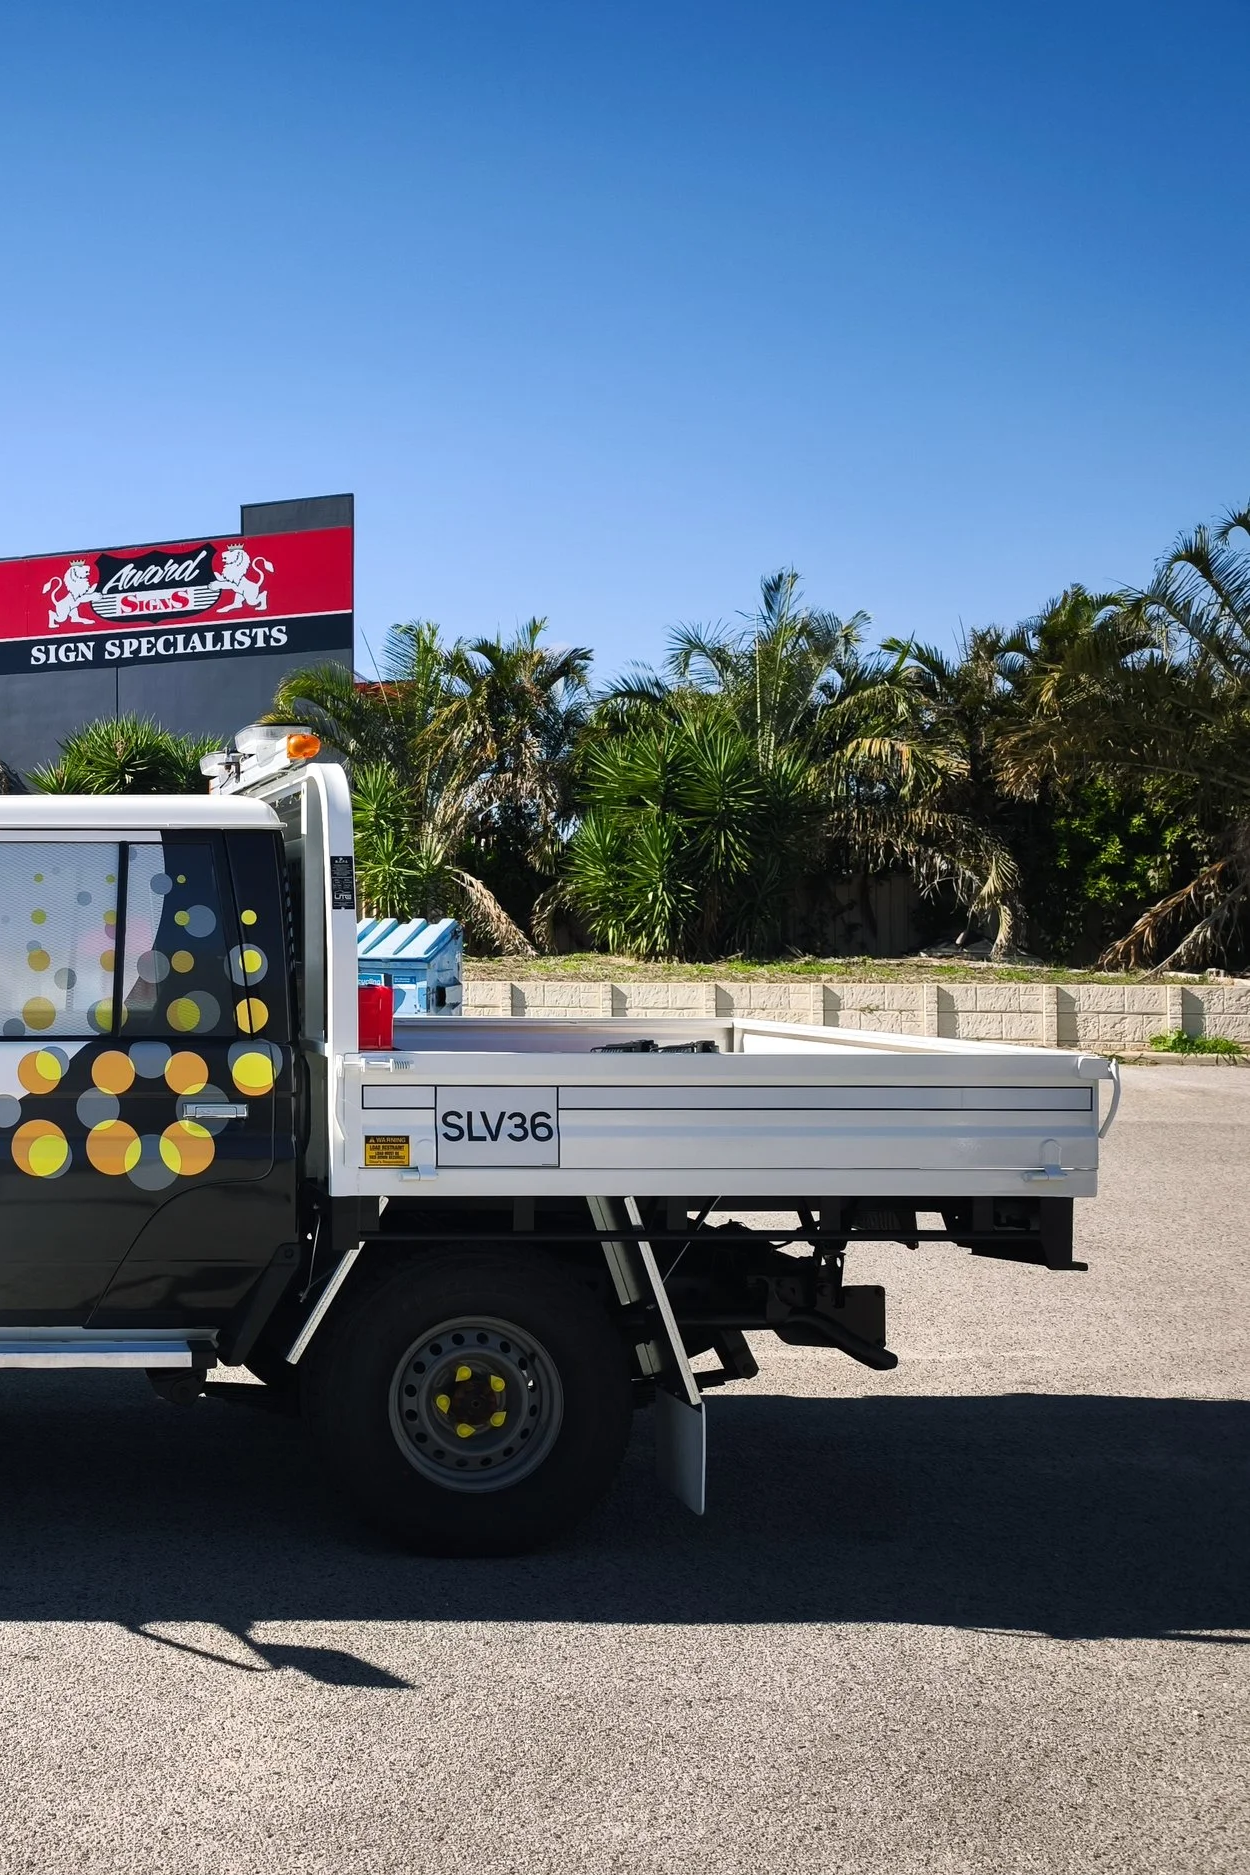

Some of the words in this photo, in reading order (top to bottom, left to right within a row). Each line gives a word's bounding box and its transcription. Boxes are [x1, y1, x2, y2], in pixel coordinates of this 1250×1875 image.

[102, 550, 207, 594] Award
[121, 589, 190, 614] SIGNS
[30, 641, 95, 665] SIGN
[104, 625, 288, 660] SPECIALISTS
[441, 1110, 554, 1142] SLV36
